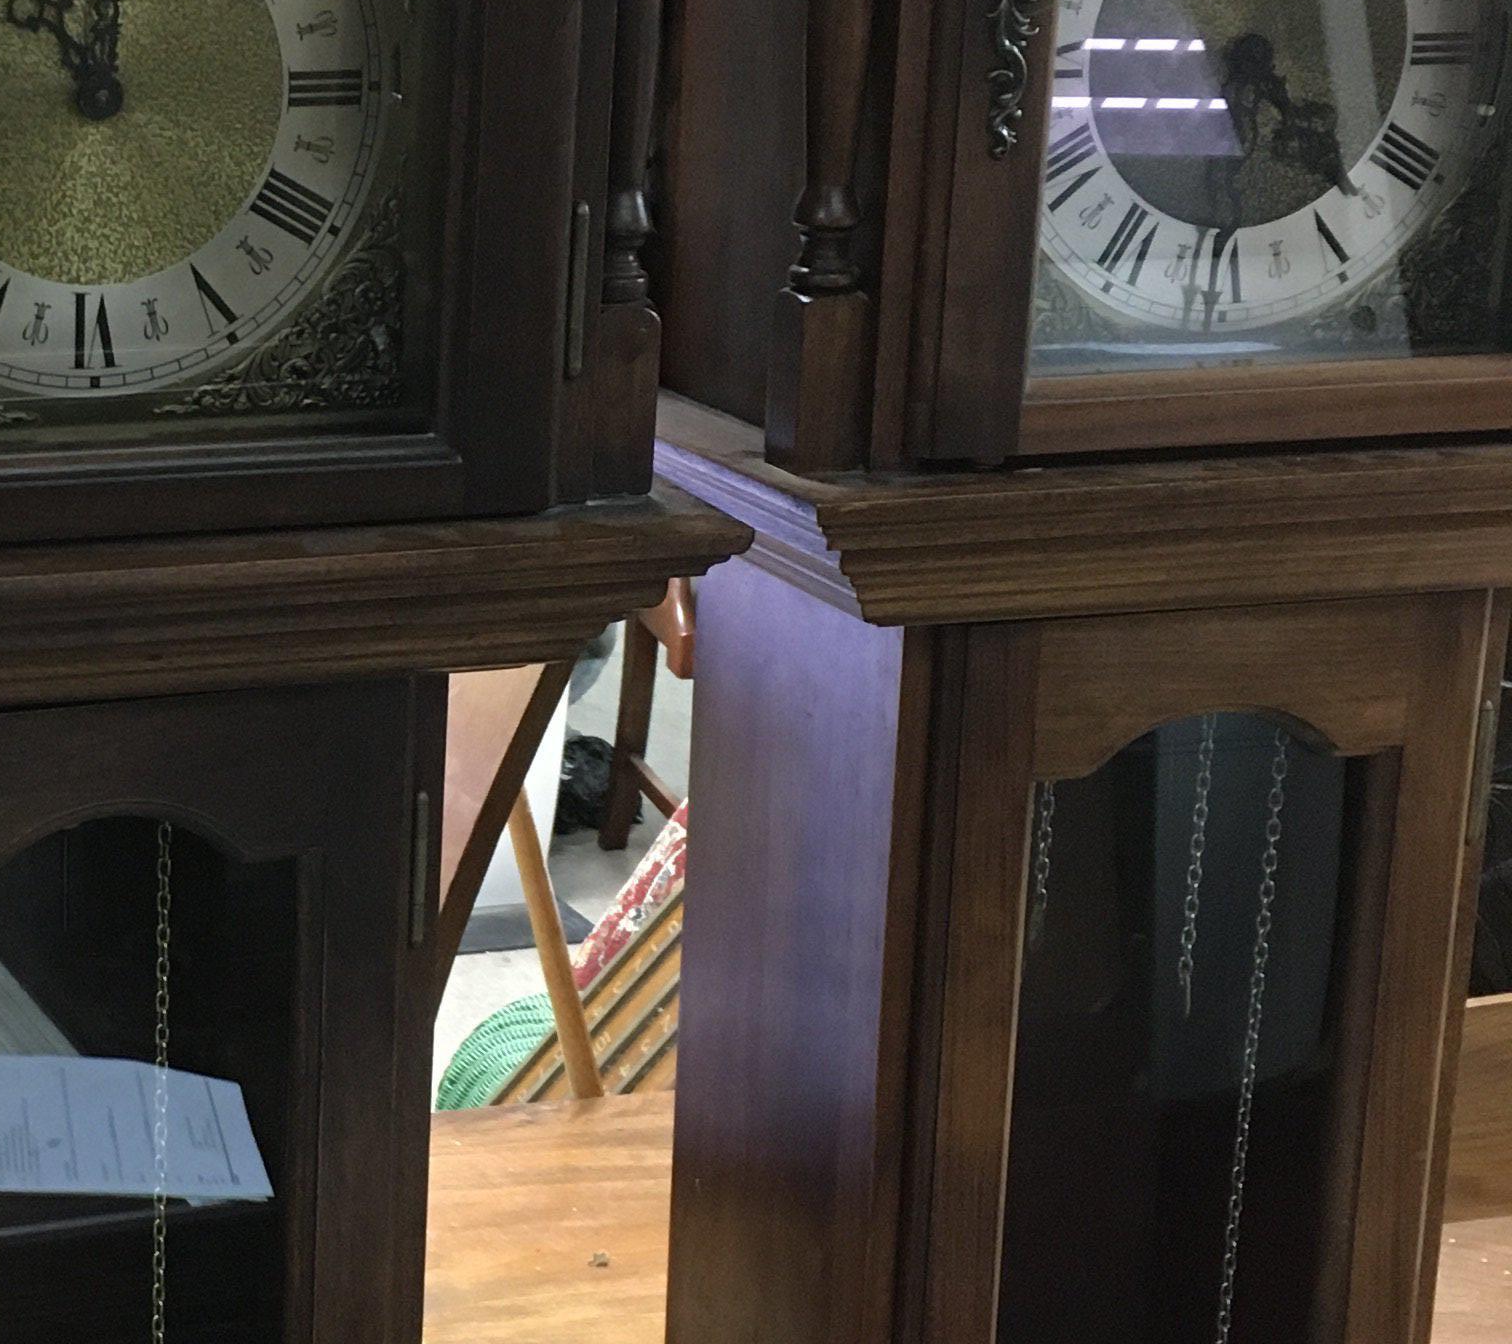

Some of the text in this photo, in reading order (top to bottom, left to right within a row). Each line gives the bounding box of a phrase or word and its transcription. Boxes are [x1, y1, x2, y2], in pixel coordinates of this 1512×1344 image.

[287, 67, 363, 114] III
[245, 163, 337, 249] IIII
[1313, 208, 1351, 274] V
[73, 292, 123, 370] VI
[189, 262, 243, 338] V
